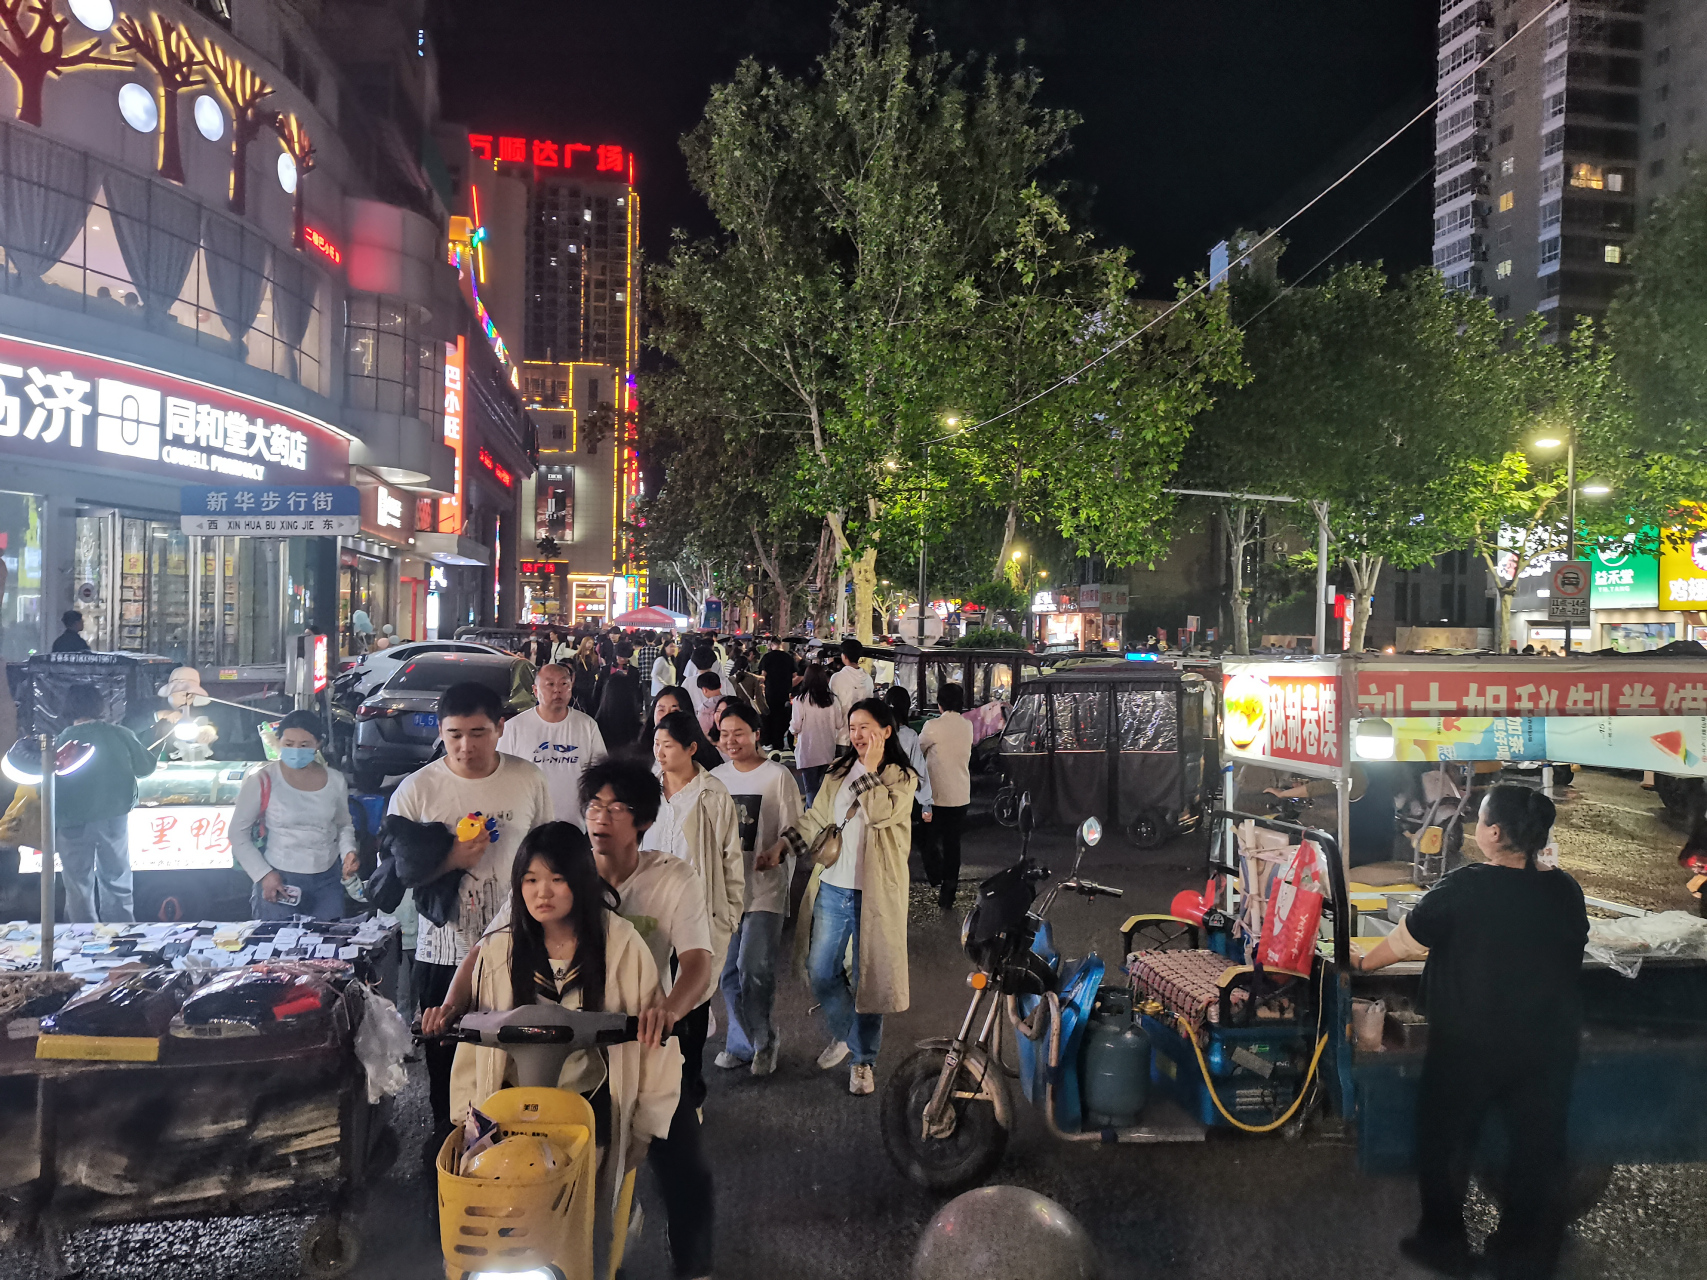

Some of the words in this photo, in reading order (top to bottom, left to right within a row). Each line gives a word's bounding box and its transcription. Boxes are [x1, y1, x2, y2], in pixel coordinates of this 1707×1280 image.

[468, 133, 624, 171] 万顺达广场
[444, 364, 461, 440] 巴小旺
[165, 396, 308, 471] 同和堂大药店
[205, 491, 334, 512] 新华步行街
[207, 519, 218, 531] 西
[227, 520, 241, 530] XIN
[244, 520, 261, 530] HUA
[265, 520, 276, 530] BU
[279, 520, 299, 530] XING
[302, 520, 314, 530] JIE
[322, 518, 334, 531] 东
[1594, 568, 1635, 586] 益禾堂
[1269, 683, 1338, 759] 秘制卷馍
[533, 755, 579, 764] LI-NING
